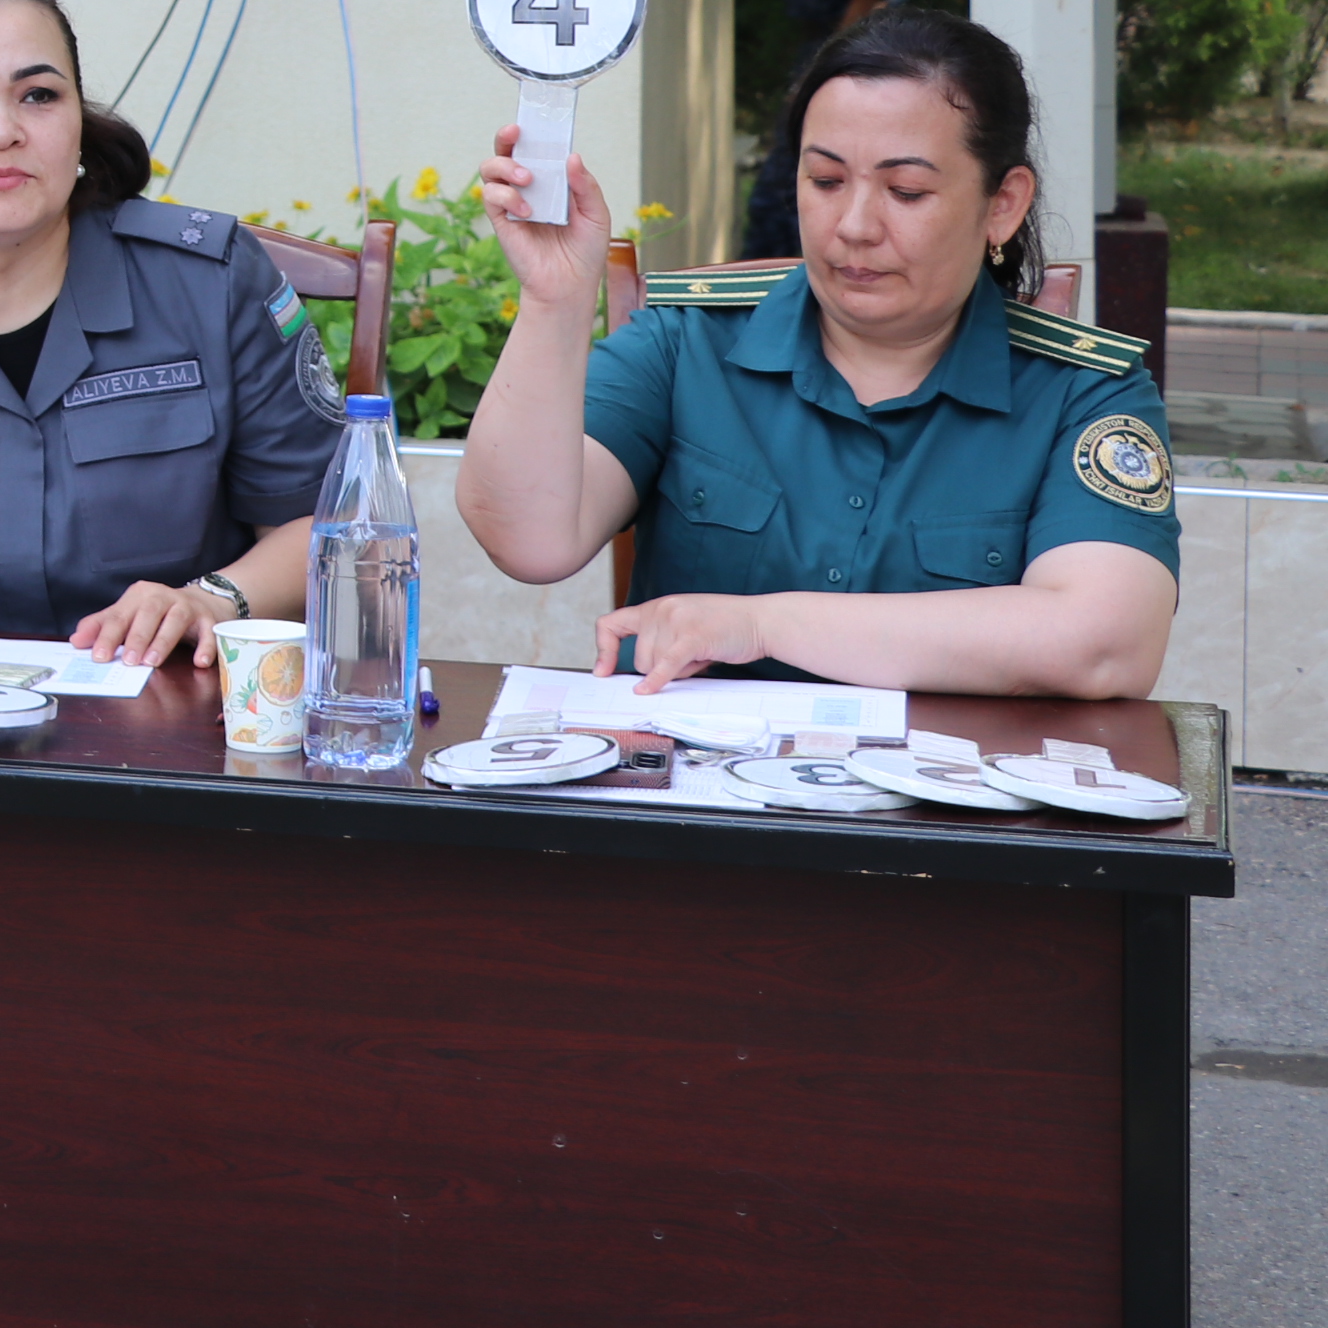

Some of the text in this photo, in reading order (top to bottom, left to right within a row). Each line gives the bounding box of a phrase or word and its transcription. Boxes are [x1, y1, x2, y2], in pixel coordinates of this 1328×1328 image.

[71, 367, 192, 402] ALIYEVA Z.M.
[1105, 486, 1142, 504] ISHLAR
[490, 738, 565, 763] 5
[790, 764, 864, 786] 3
[1073, 767, 1127, 790] 1
